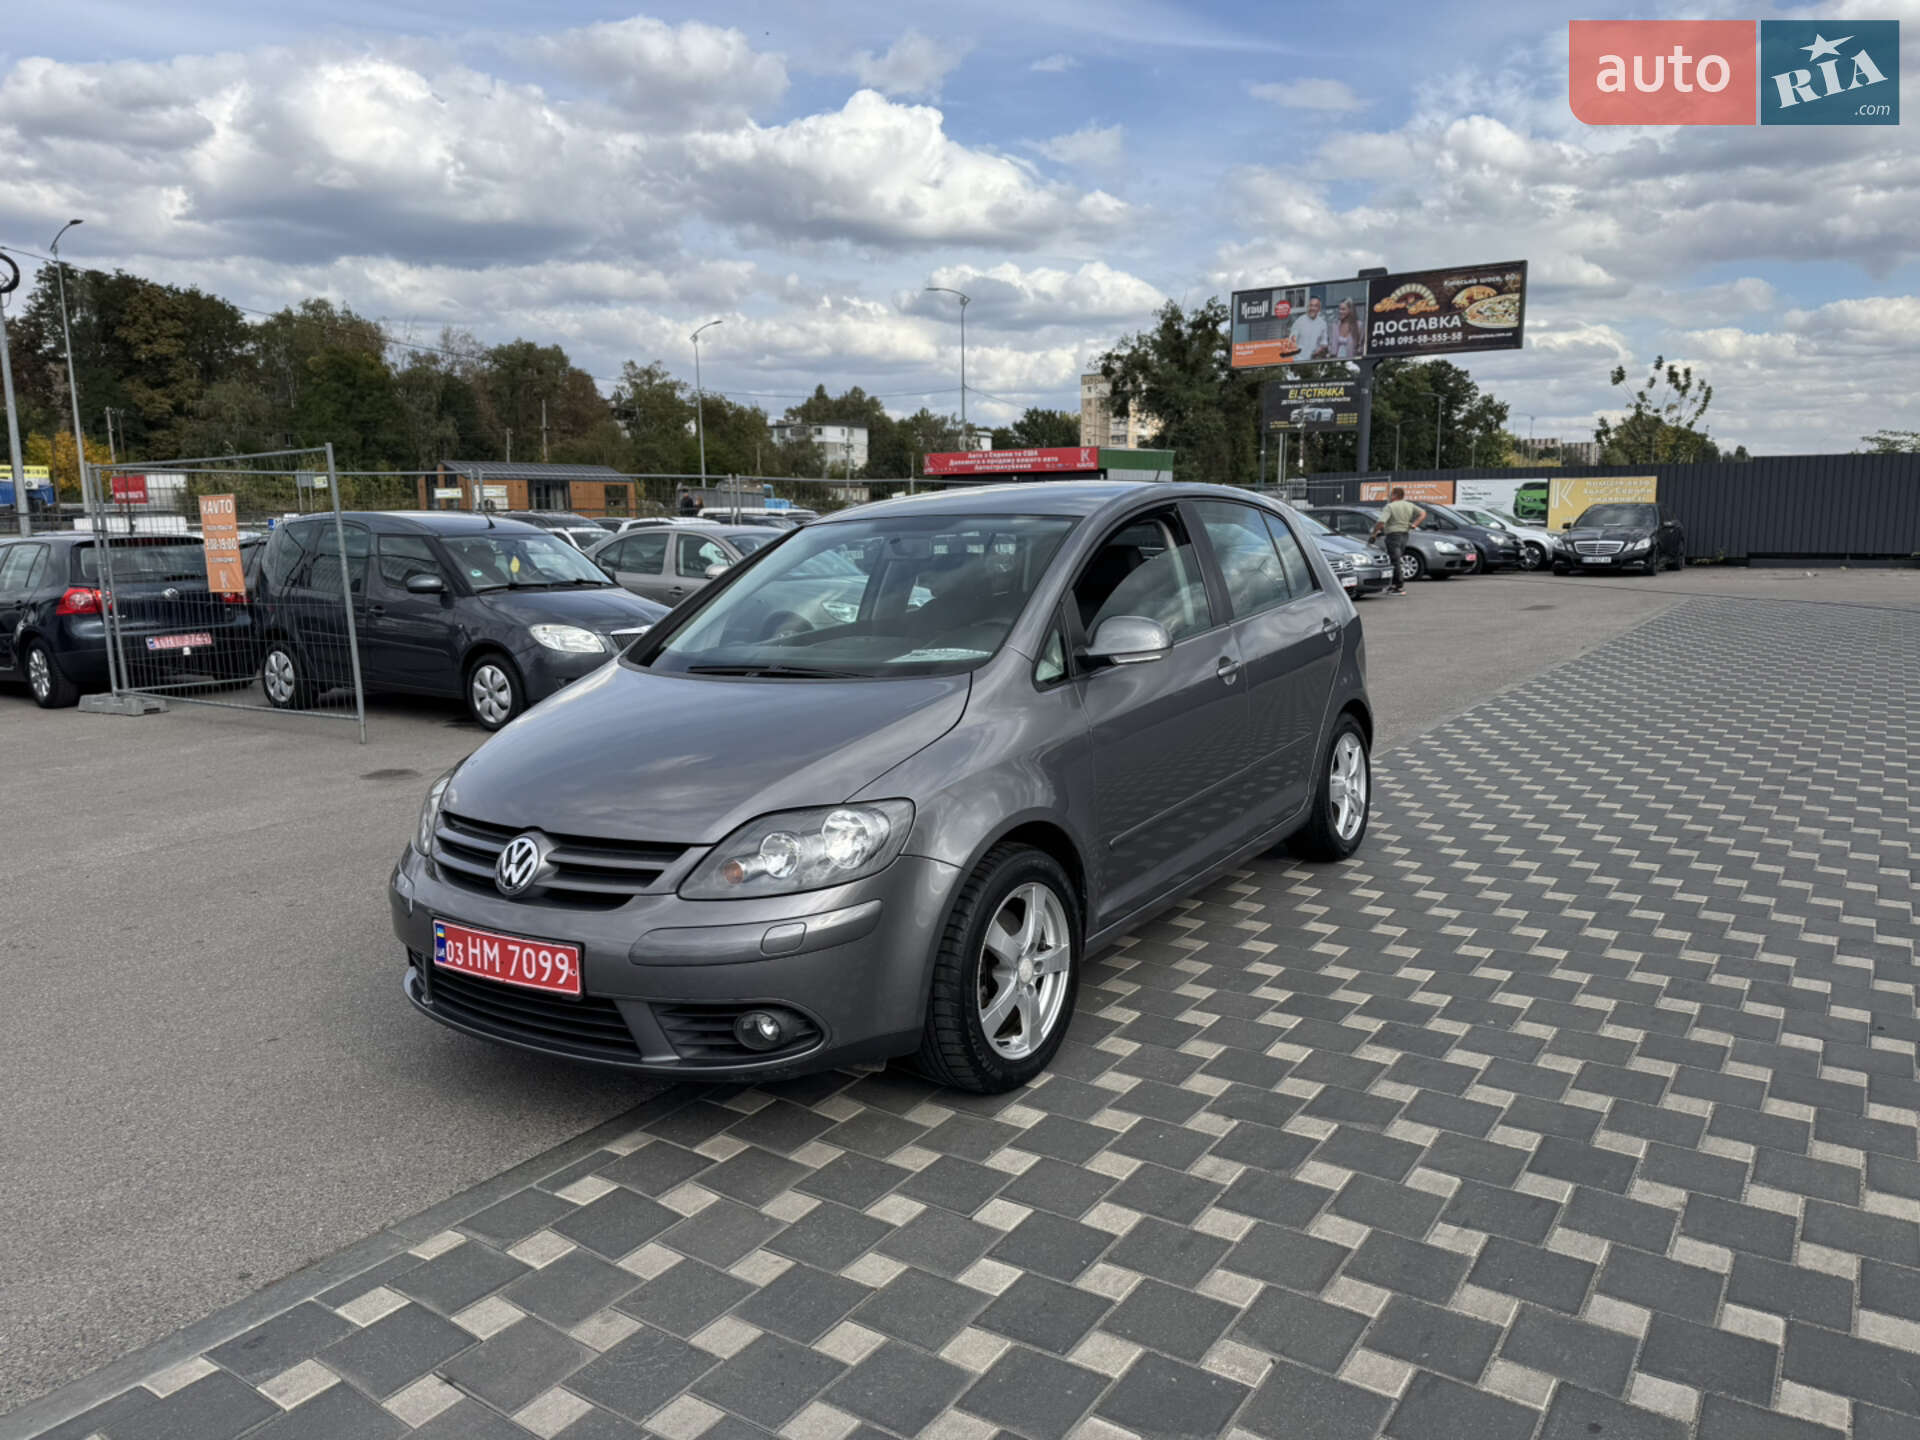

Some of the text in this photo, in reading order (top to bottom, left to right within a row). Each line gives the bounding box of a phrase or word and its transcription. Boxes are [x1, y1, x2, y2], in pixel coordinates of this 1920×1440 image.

[1372, 314, 1462, 336] ДОСТАВКА
[446, 940, 464, 966] 03
[468, 936, 501, 974] HM
[507, 945, 569, 985] 7099
